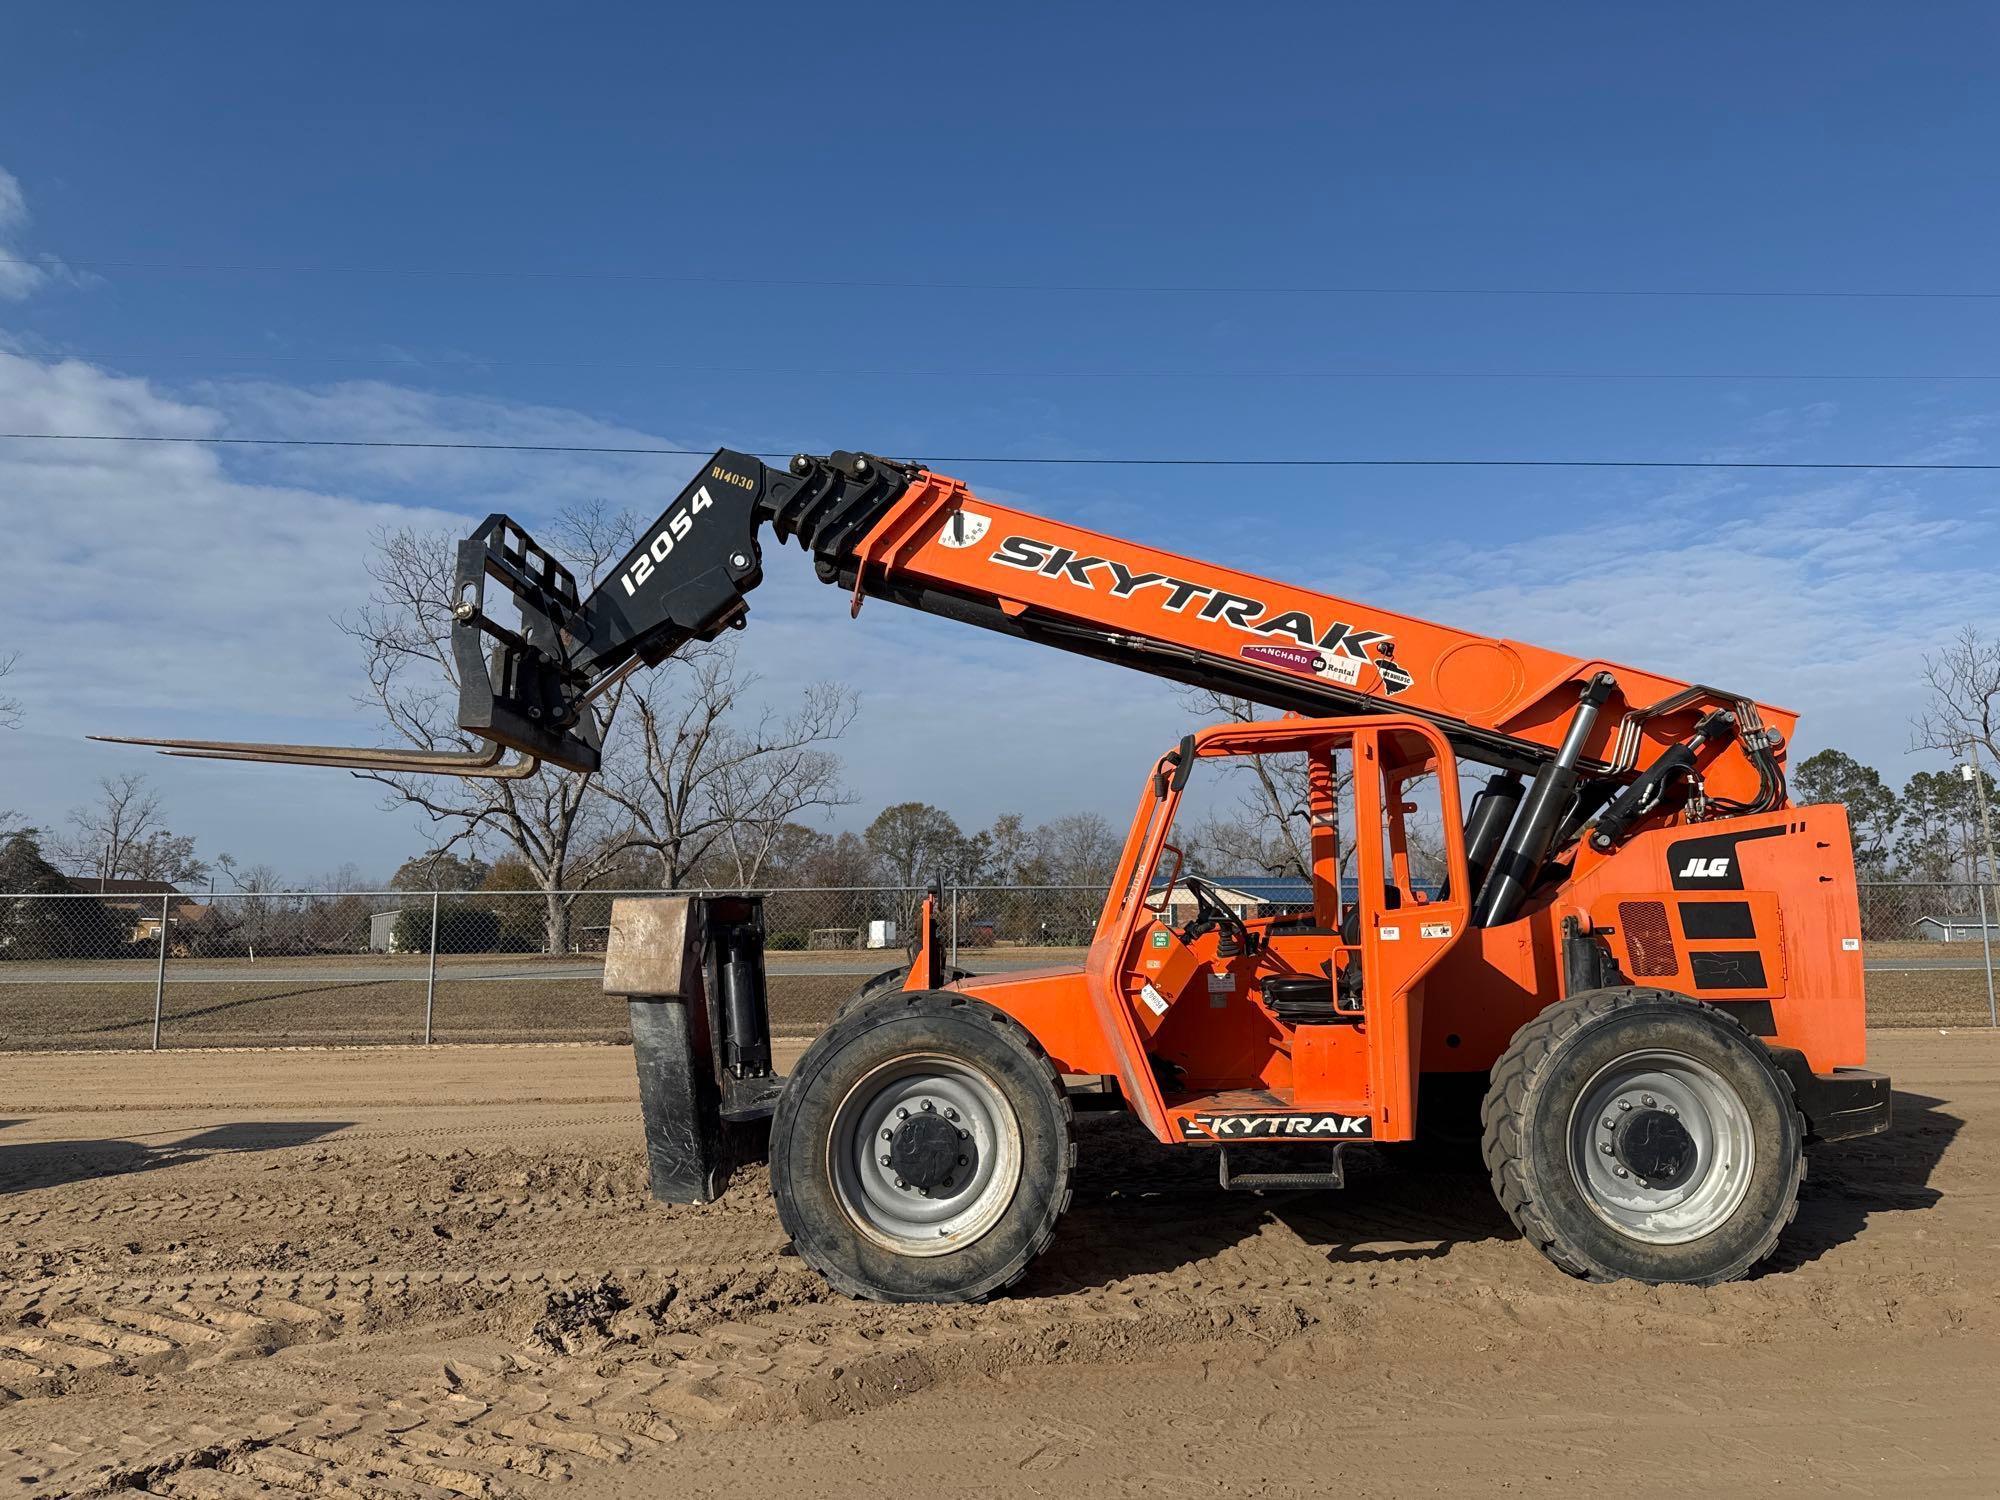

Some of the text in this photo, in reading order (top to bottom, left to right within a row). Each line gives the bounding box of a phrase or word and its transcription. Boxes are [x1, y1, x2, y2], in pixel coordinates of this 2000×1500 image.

[620, 485, 714, 597] 12054
[987, 535, 1395, 665] SKYTRAK
[1250, 647, 1308, 664] ANCHARD
[1312, 659, 1355, 677] CAT Rental
[1679, 858, 1730, 877] JLG
[1185, 1117, 1368, 1134] SKYTRAK
